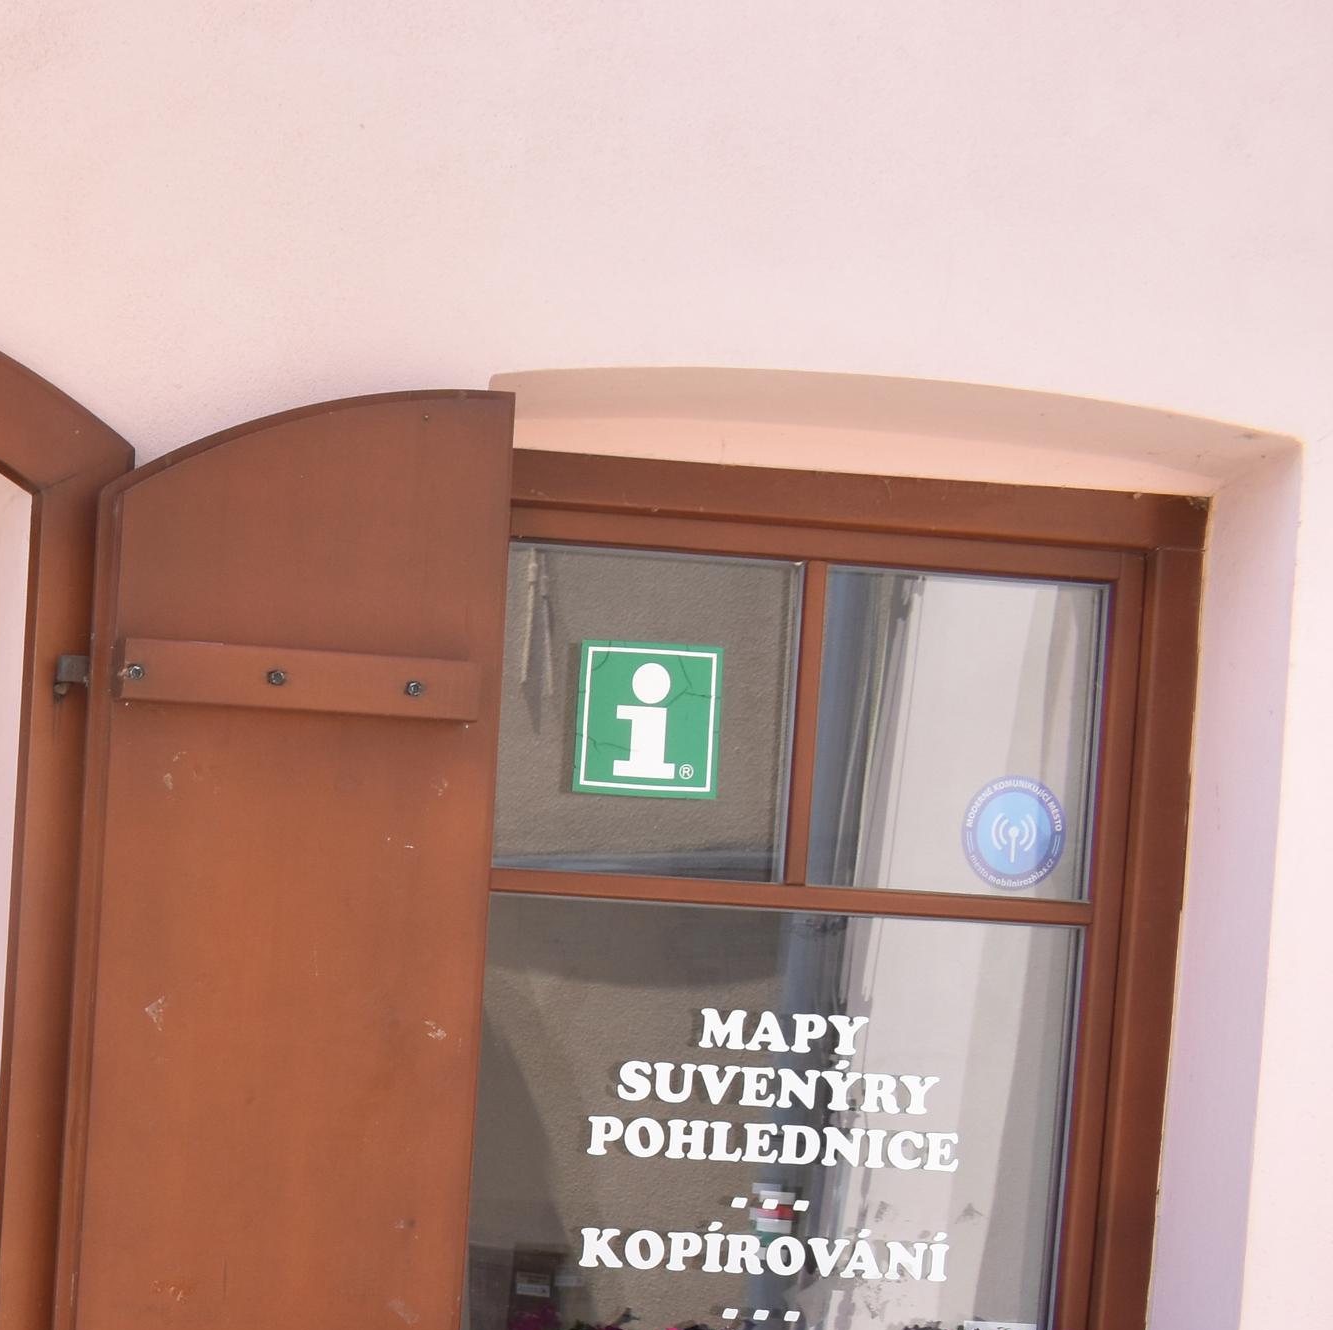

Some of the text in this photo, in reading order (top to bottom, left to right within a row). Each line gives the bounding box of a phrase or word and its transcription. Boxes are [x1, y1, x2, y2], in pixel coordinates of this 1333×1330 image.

[698, 1008, 869, 1056] MAPY
[617, 1060, 940, 1115] SUVENÝRY
[586, 1115, 959, 1172] POHLEDNICE
[578, 1221, 950, 1282] KOPÍROVÁNÍ
